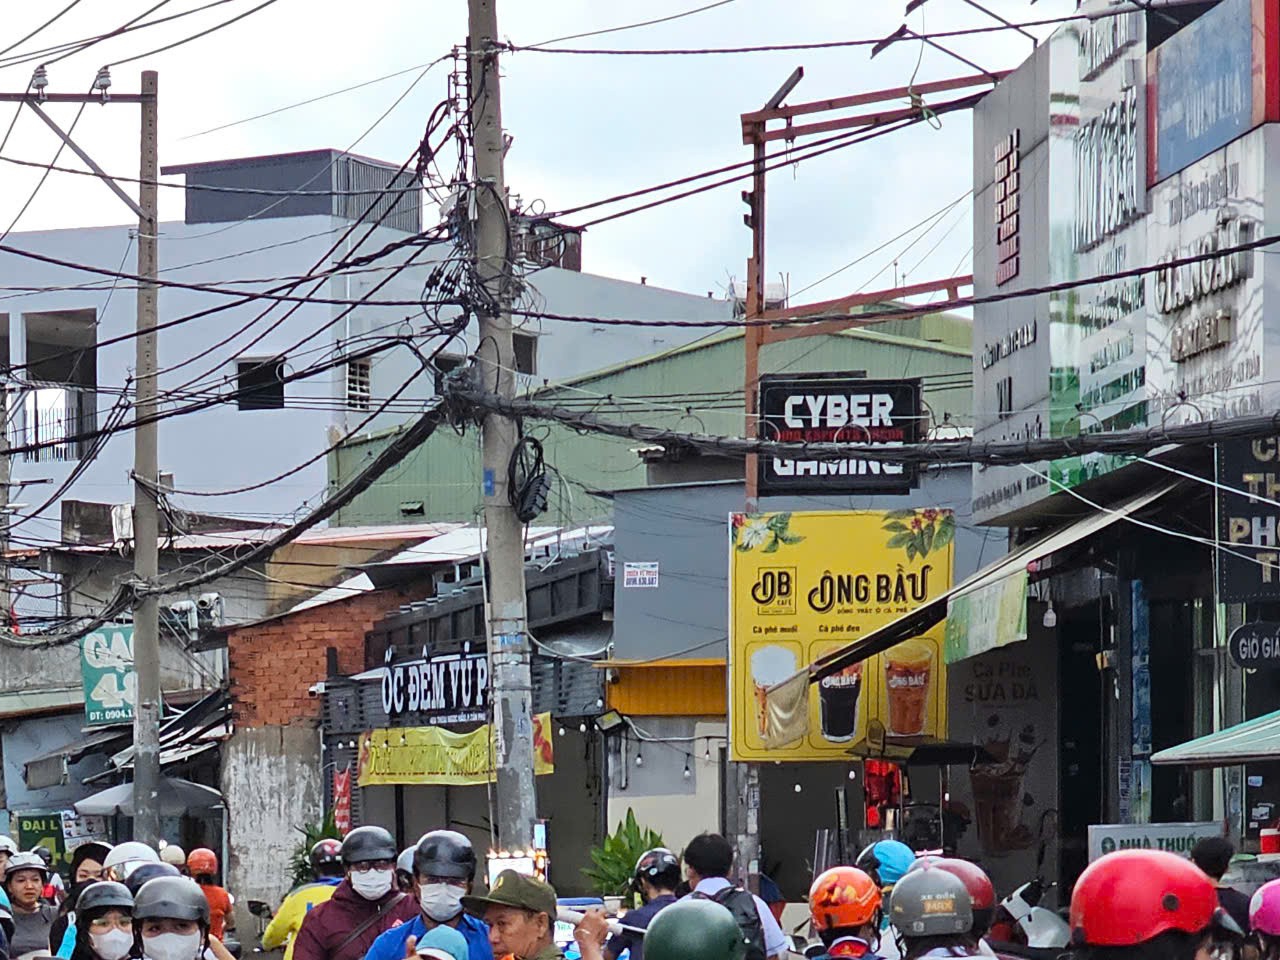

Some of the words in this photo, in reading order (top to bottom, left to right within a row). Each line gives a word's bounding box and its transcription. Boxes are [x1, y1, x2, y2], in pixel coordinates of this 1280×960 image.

[784, 394, 894, 429] CYBER
[808, 570, 872, 615] ÔNG
[876, 563, 933, 604] BẦU
[84, 632, 134, 673] GẠ
[408, 644, 446, 711] ĐÊM
